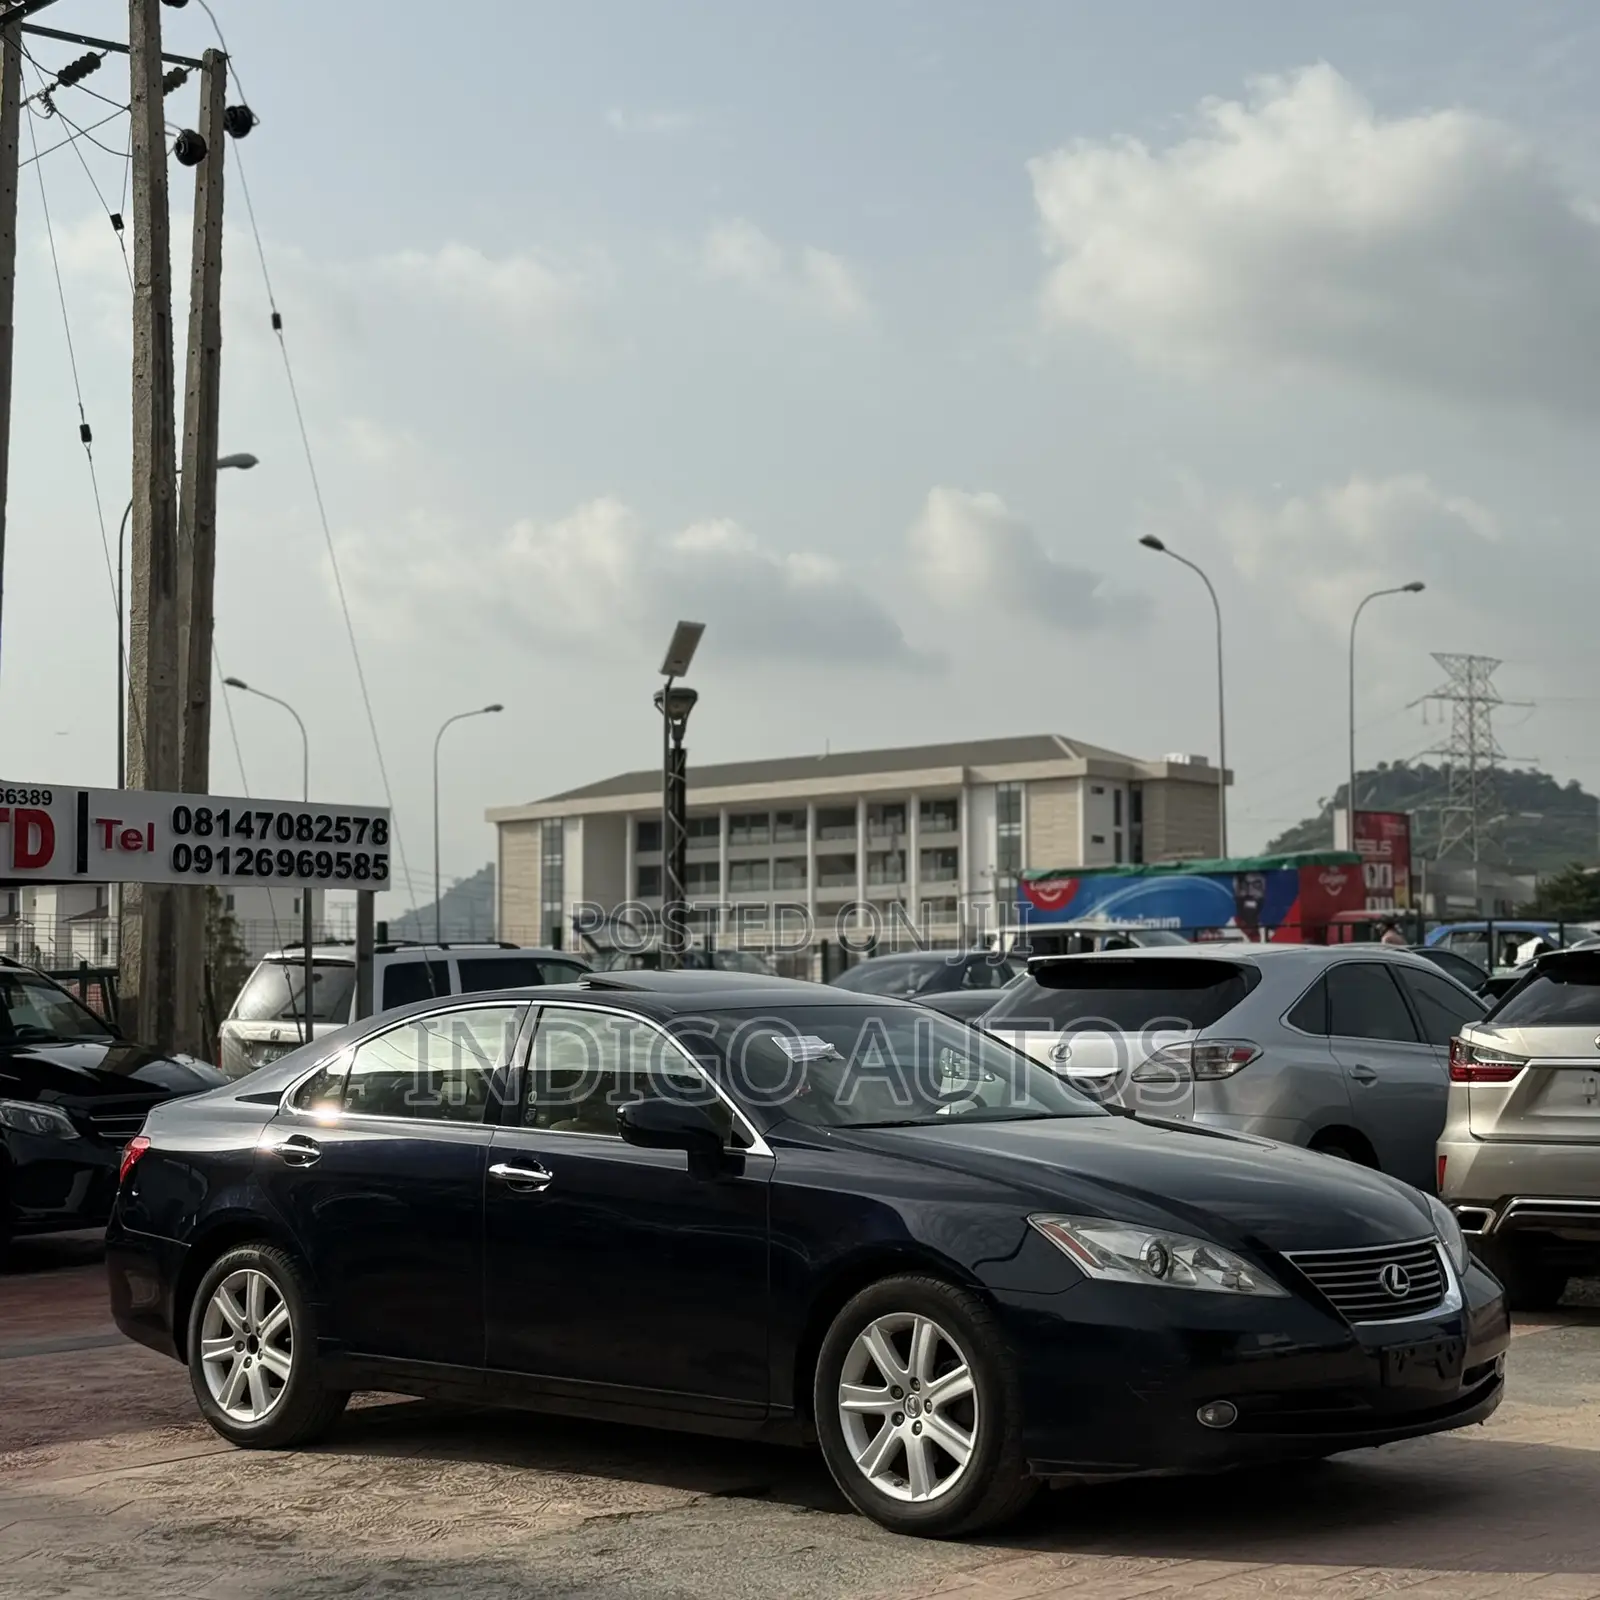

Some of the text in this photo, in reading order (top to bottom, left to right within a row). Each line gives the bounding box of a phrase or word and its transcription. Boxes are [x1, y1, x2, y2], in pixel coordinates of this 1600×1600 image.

[95, 817, 155, 852] Tel
[172, 806, 388, 846] 08147082578
[172, 843, 389, 881] 09126969585
